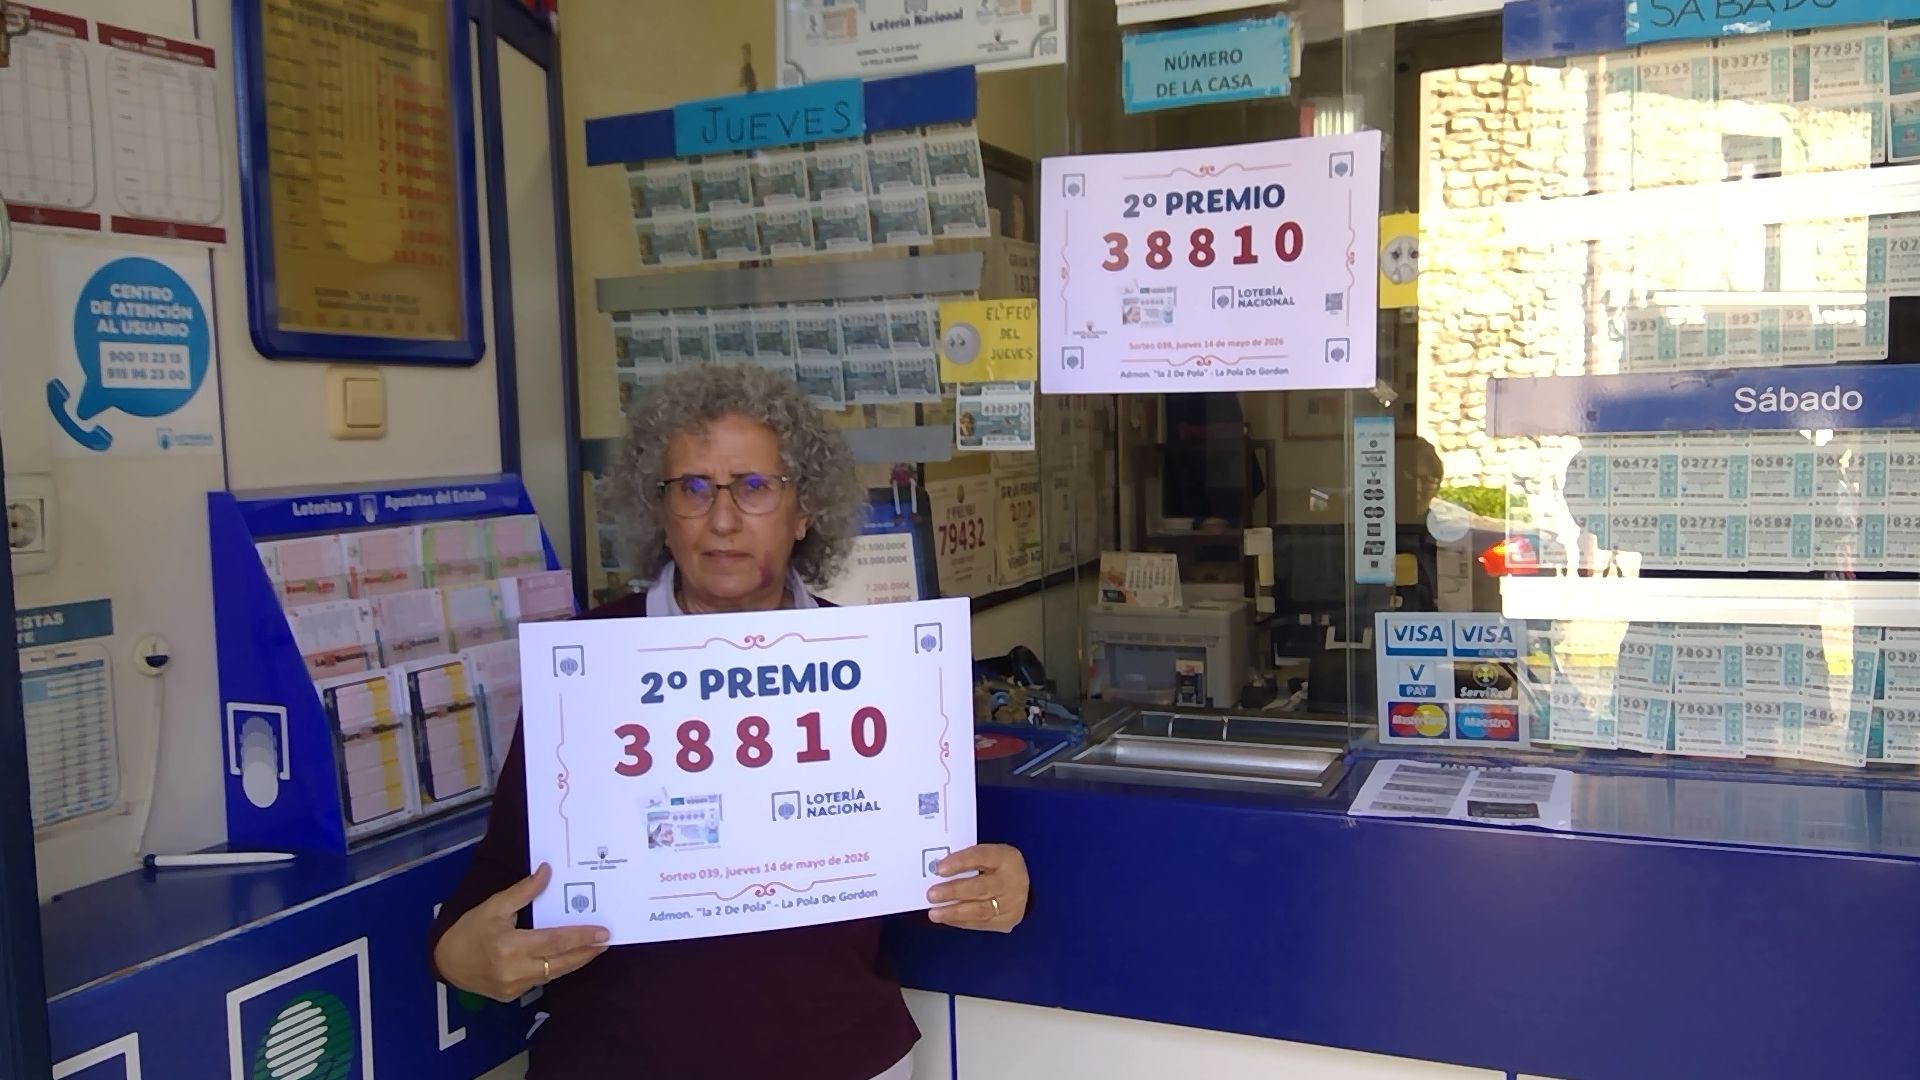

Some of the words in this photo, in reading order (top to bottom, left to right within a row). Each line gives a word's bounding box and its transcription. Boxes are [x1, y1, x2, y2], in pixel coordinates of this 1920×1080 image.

[914, 7, 964, 25] Nacional
[1164, 48, 1243, 71] NÚMERO
[1156, 82, 1178, 98] DE
[1183, 78, 1203, 94] LA
[1208, 73, 1253, 91] CASA
[702, 101, 850, 144] JUEVES
[1123, 193, 1157, 218] 2º
[1166, 183, 1286, 216] PREMIO
[110, 283, 173, 301] CENTRO
[1238, 286, 1284, 298] LOTERÍA
[90, 300, 113, 315] DE
[116, 300, 193, 320] ATENCIÓN
[1238, 296, 1295, 309] NACIONAL
[985, 306, 1000, 321] EL
[97, 319, 120, 335] AL
[121, 320, 190, 338] USUARIO
[1000, 328, 1020, 340] DEL
[1129, 341, 1155, 351] Sorteo
[1176, 340, 1201, 352] jueves
[1204, 339, 1214, 348] 14
[1215, 339, 1226, 347] de
[1228, 339, 1250, 350] mayo
[1252, 338, 1262, 346] de
[1264, 337, 1284, 346] 2026
[109, 351, 135, 363] 900
[151, 352, 166, 364] 23
[990, 349, 1034, 361] JUEVES
[168, 369, 186, 381] 00
[1174, 369, 1185, 378] De
[1215, 368, 1224, 376] La
[1226, 367, 1243, 376] Pola
[1245, 367, 1256, 376] De
[1259, 366, 1289, 377] Gordon
[1734, 385, 1863, 413] Sábado
[1612, 457, 1659, 469] 66472
[1681, 457, 1729, 469] 02772
[1751, 456, 1794, 467] 6582
[292, 499, 343, 517] Loterías
[344, 501, 353, 516] y
[384, 494, 434, 512] Apuestas
[435, 490, 452, 505] del
[453, 487, 487, 504] Estado
[1679, 516, 1727, 528] 02772
[1750, 516, 1792, 528] 6582
[938, 517, 986, 557] 79432
[1392, 625, 1444, 642] VISA
[1460, 625, 1513, 643] VISA
[1408, 664, 1425, 681] V
[640, 671, 688, 705] 2º
[700, 659, 862, 700] PREMIO
[1405, 686, 1429, 696] PAY
[1460, 686, 1513, 699] ServiRed
[1463, 716, 1513, 729] Maestro
[806, 787, 866, 806] LOTERÍA
[806, 800, 882, 819] NACIONAL
[659, 871, 697, 883] Sorteo
[698, 868, 723, 880] 039,
[725, 865, 761, 879] jueves
[764, 863, 777, 873] 14
[780, 861, 793, 871] de
[796, 858, 826, 871] mayo
[828, 856, 842, 866] de
[844, 852, 870, 864] 2026
[649, 910, 694, 922] Admon.
[696, 907, 712, 918] "la
[715, 906, 722, 916] 2
[725, 905, 740, 915] De
[743, 901, 771, 913] Pola"
[782, 899, 793, 909] La
[797, 895, 820, 906] Pola
[822, 893, 837, 904] De
[839, 888, 879, 901] Gordon
